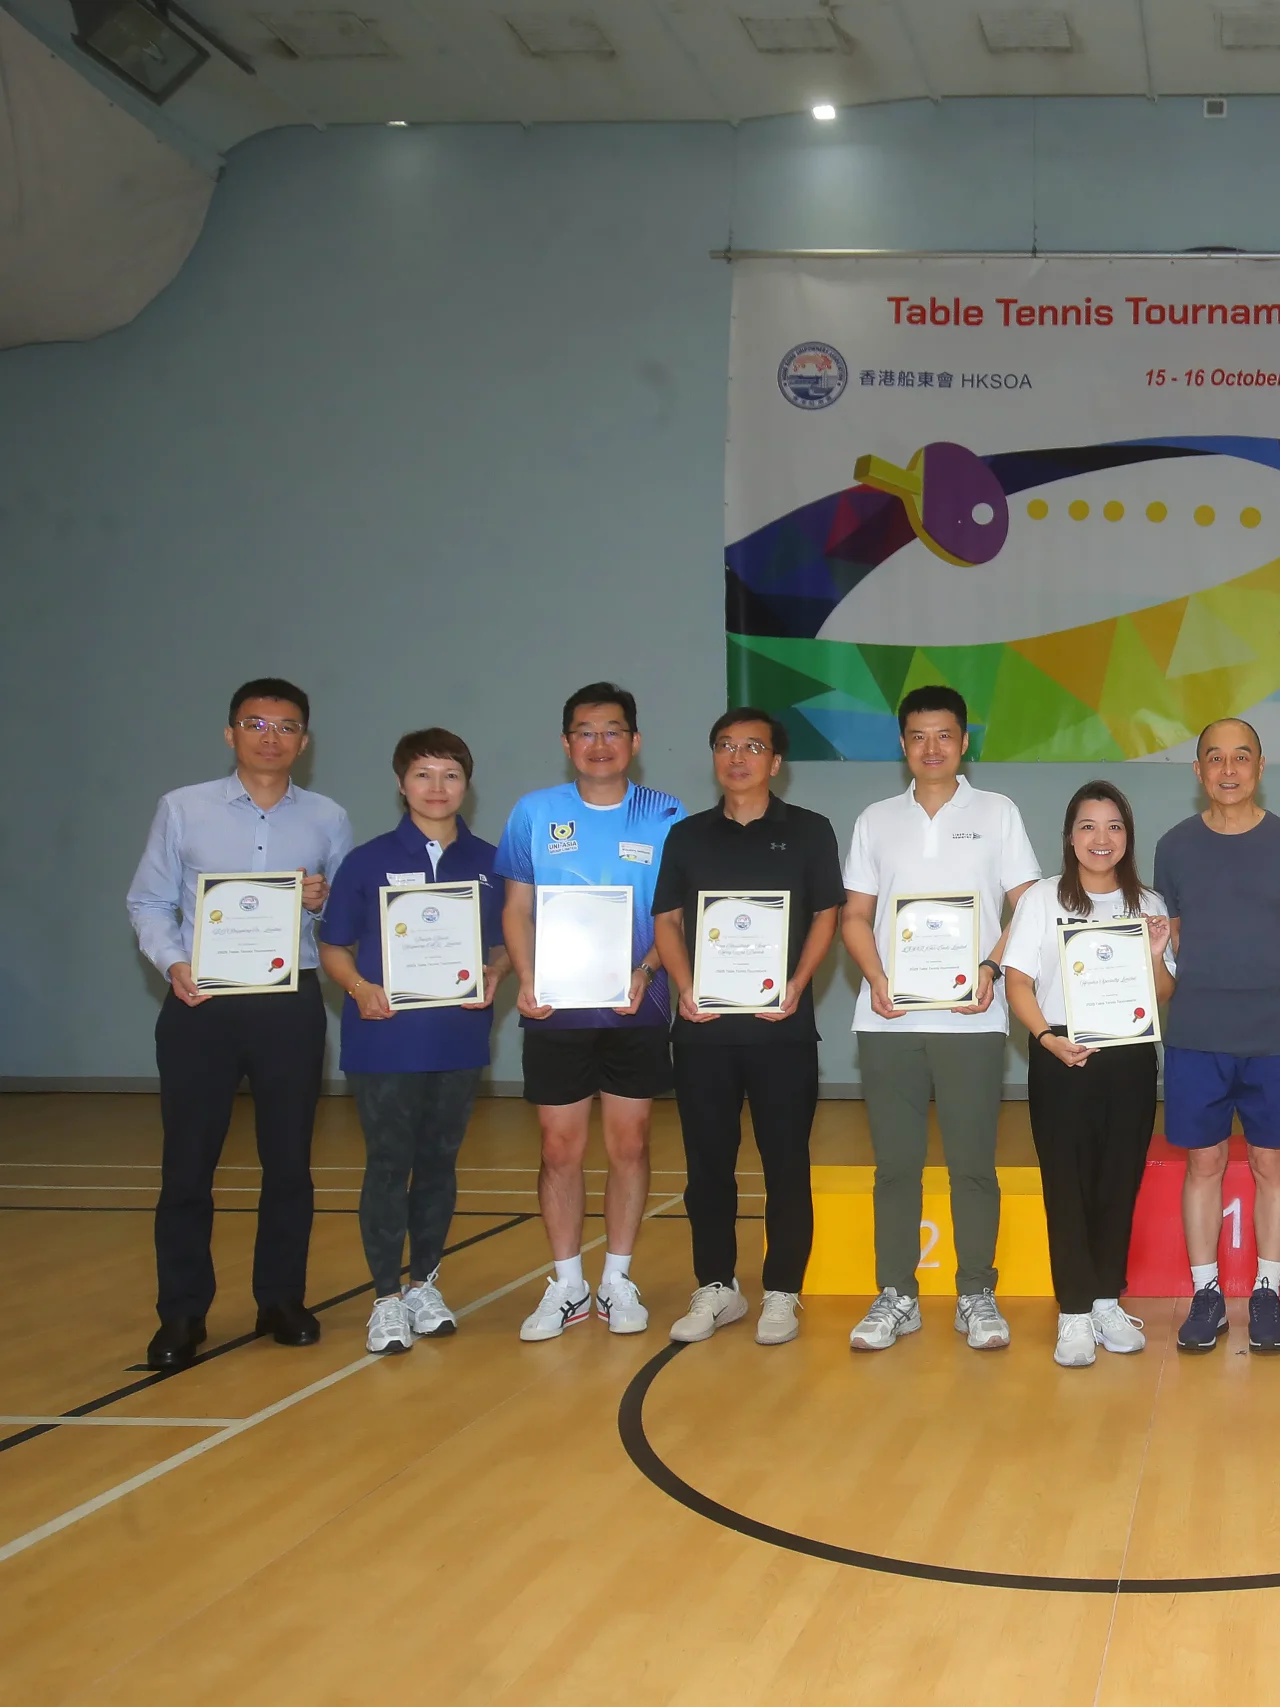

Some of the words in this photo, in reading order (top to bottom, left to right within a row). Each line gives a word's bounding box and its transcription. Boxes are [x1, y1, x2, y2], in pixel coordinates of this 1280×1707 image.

[887, 296, 984, 328] Table
[996, 297, 1114, 328] Tennis
[859, 369, 954, 388] 香港船東會
[961, 373, 1033, 390] HKSOA
[1145, 369, 1166, 387] 15
[1184, 369, 1205, 387] 16
[1222, 1197, 1241, 1249] 1
[917, 1220, 940, 1268] 2
